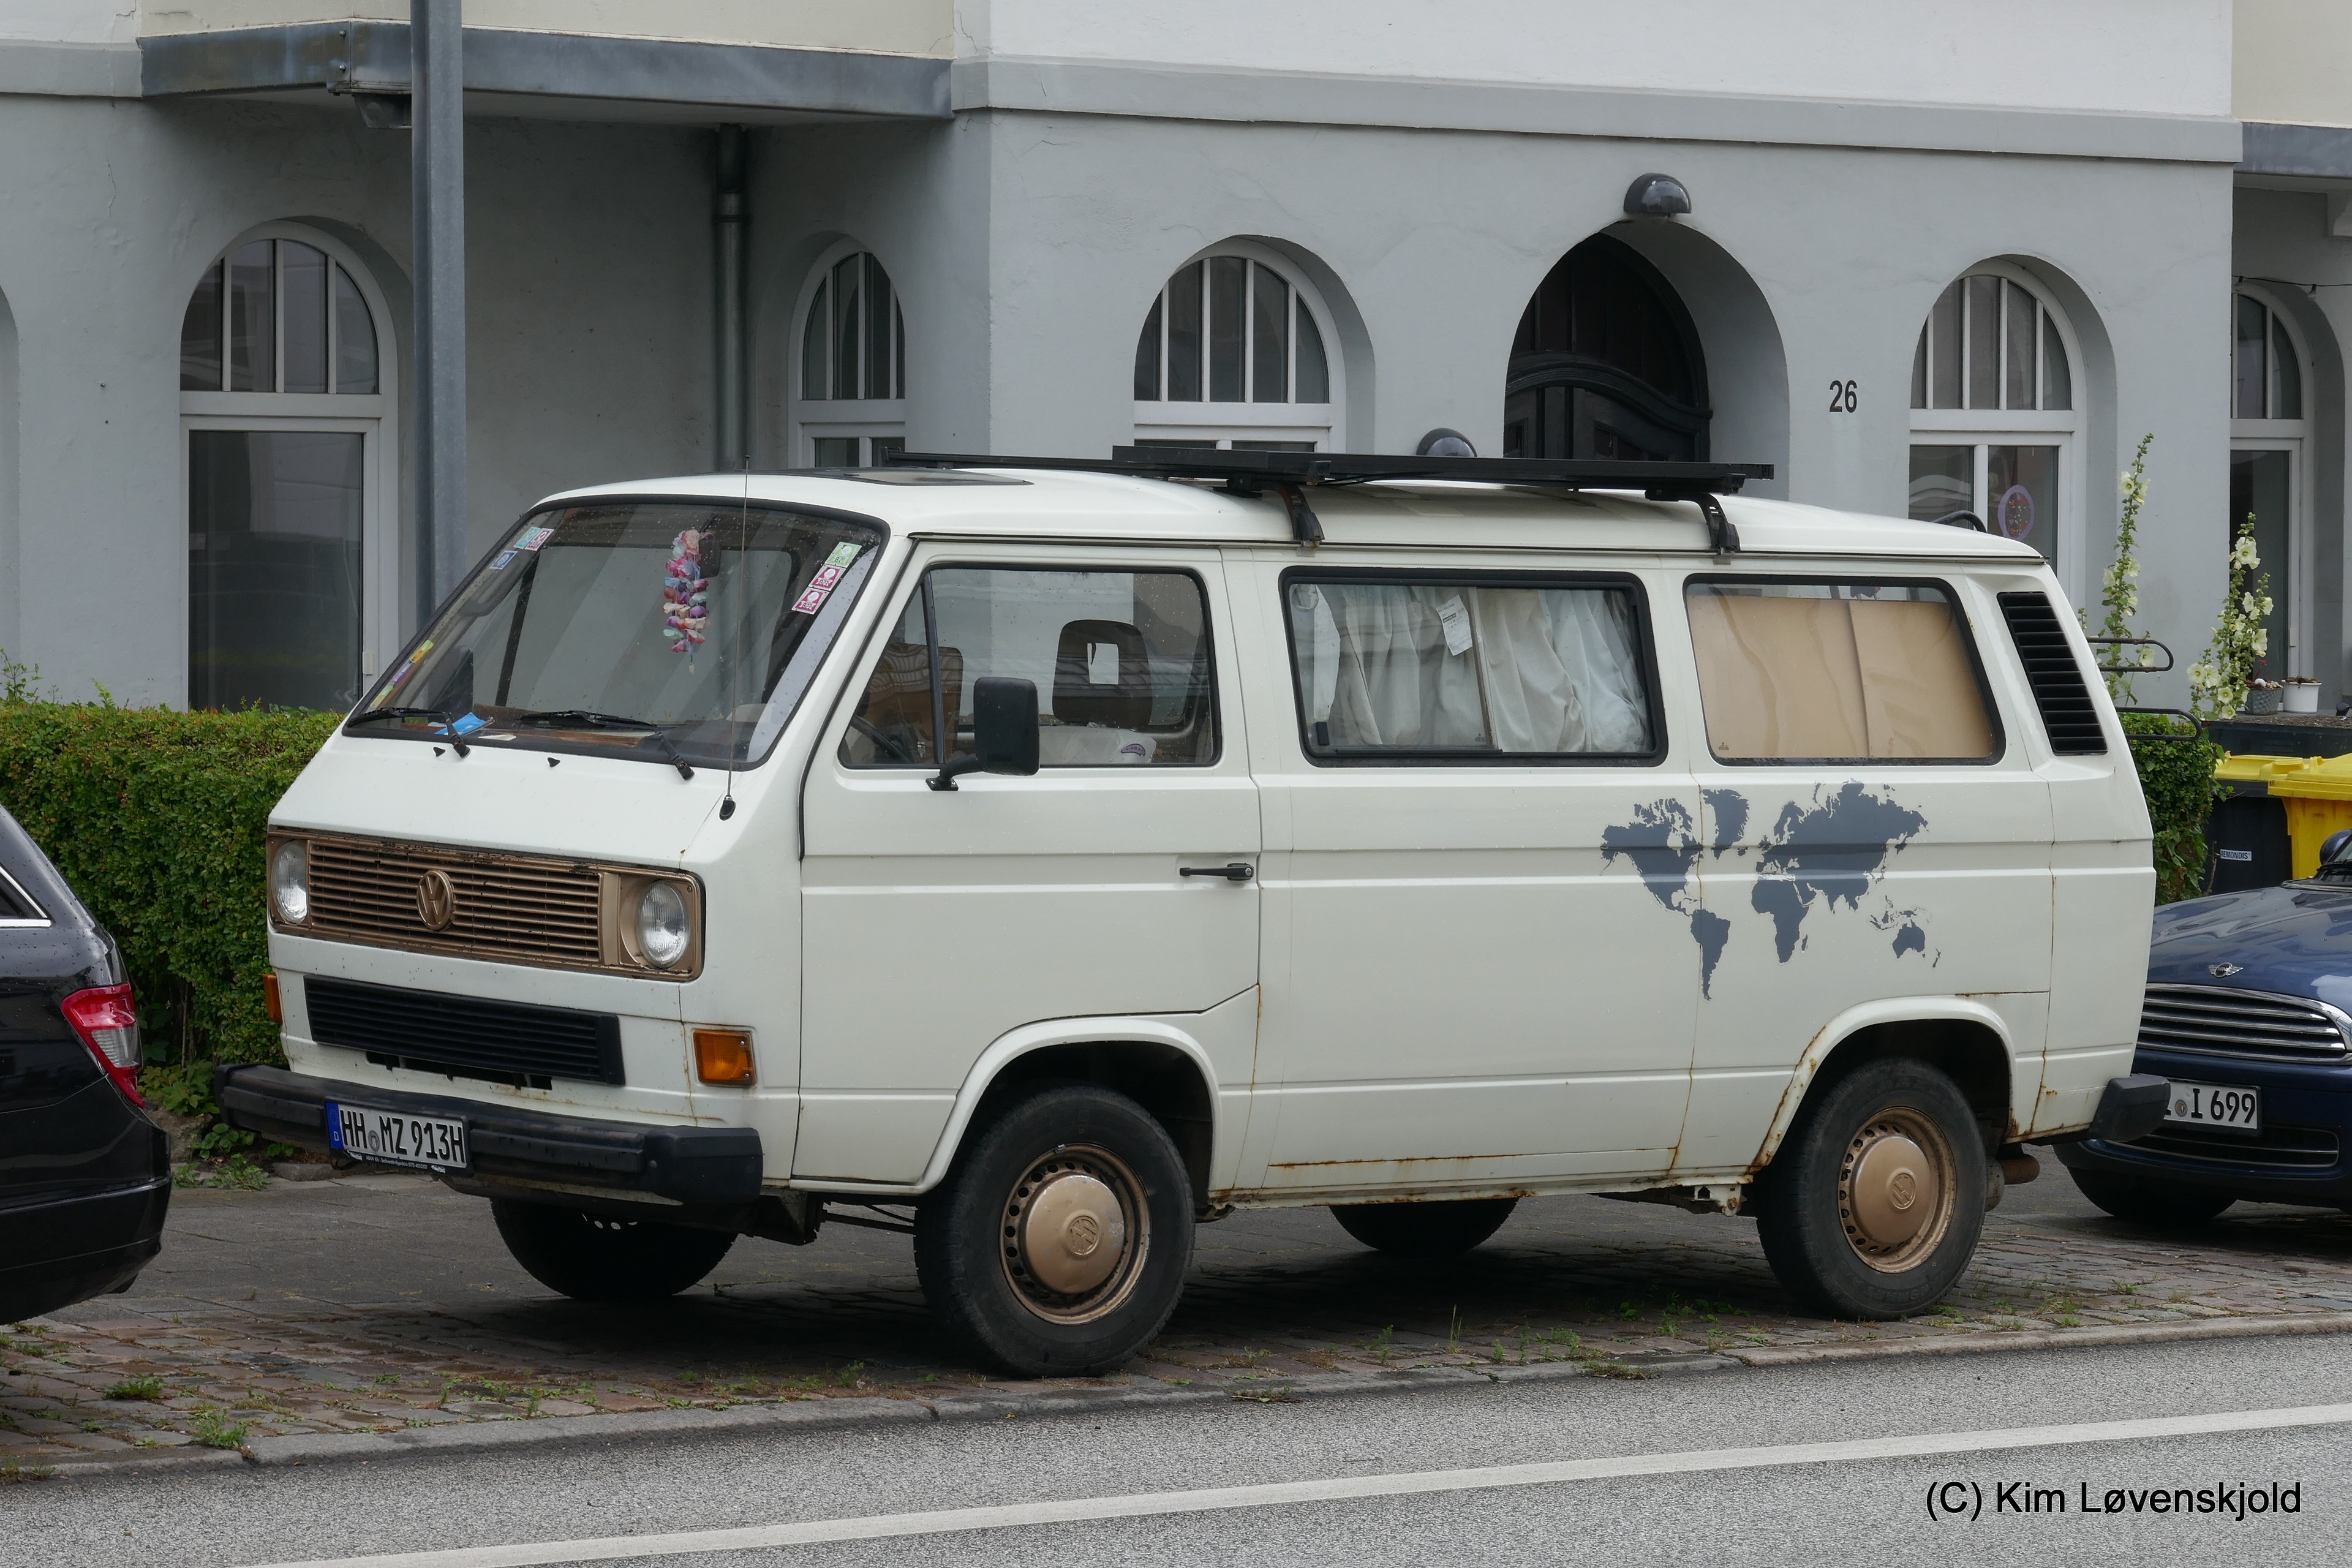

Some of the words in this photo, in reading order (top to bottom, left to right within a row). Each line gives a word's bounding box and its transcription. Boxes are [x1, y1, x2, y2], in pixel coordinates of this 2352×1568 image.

[1829, 380, 1857, 413] 26
[417, 872, 452, 929] VW
[2191, 1088, 2203, 1119] I
[2210, 1090, 2256, 1123] 699
[333, 1131, 339, 1142] D
[340, 1110, 368, 1148] HH
[379, 1115, 407, 1155] MZ
[411, 1121, 465, 1163] 913H
